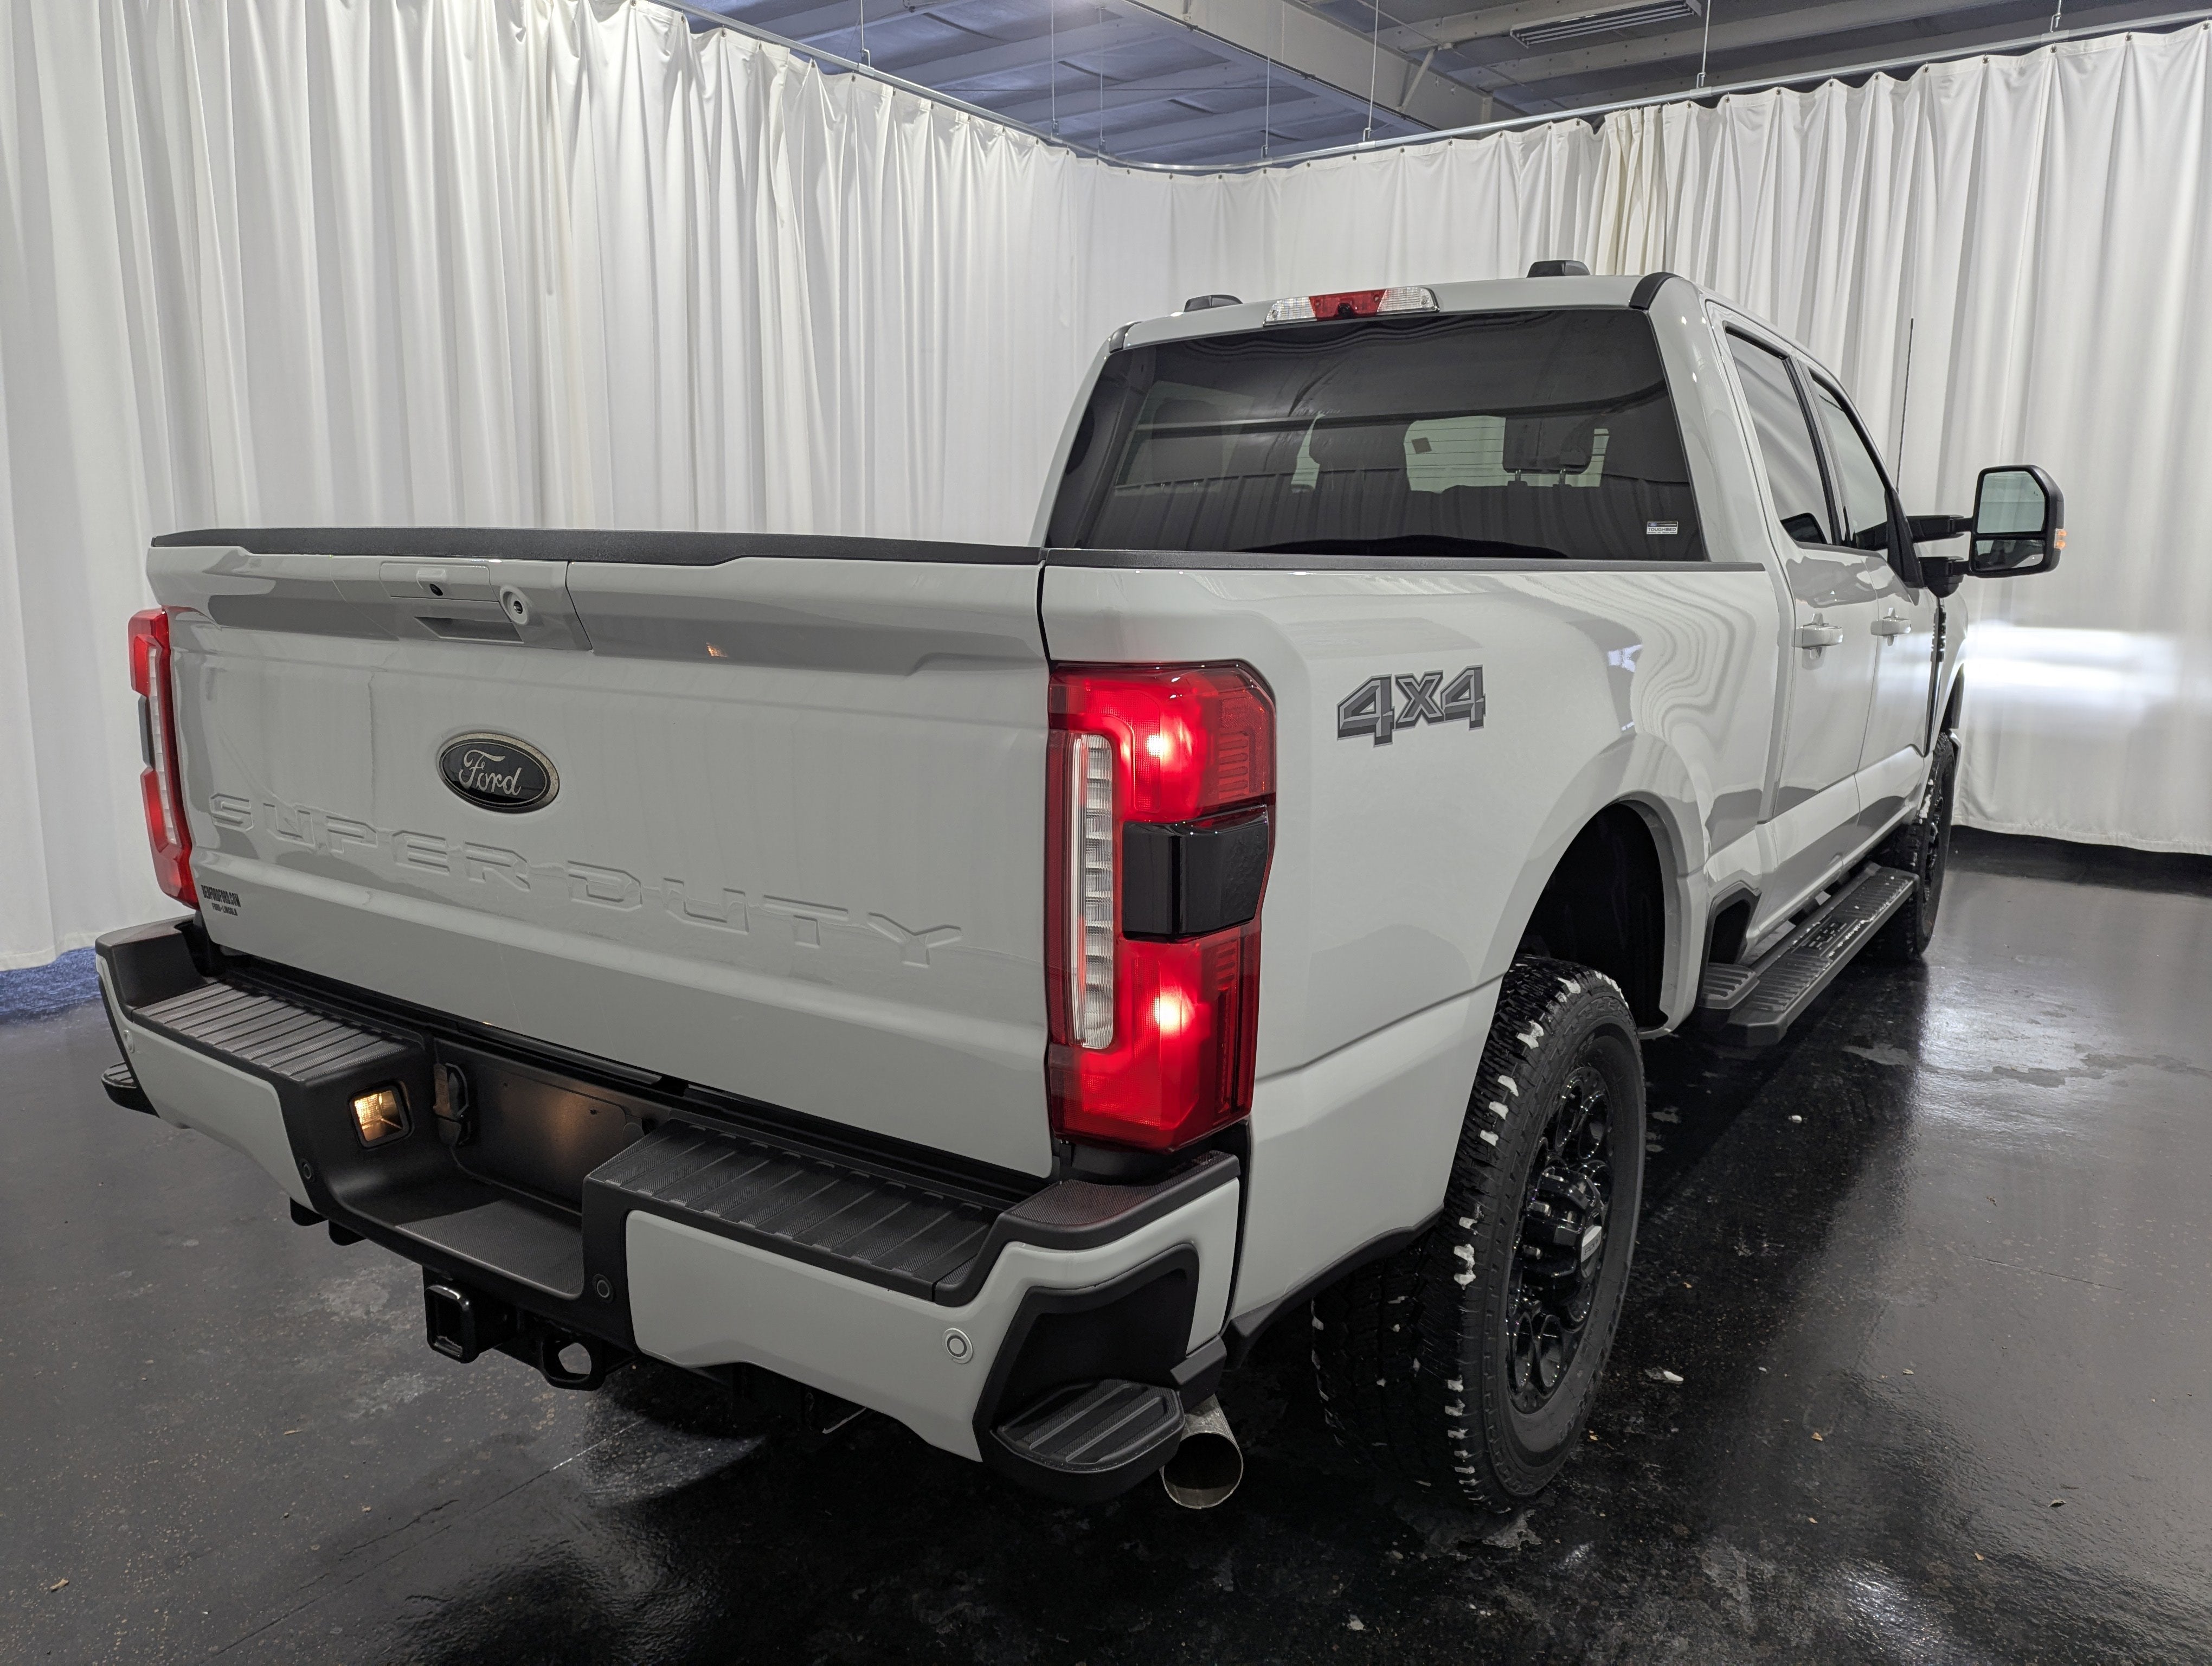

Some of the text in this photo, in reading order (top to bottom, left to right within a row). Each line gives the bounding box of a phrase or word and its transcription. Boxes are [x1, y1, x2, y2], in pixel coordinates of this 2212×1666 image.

[459, 749, 522, 796] Ford
[209, 793, 962, 968] SUPER DUTY
